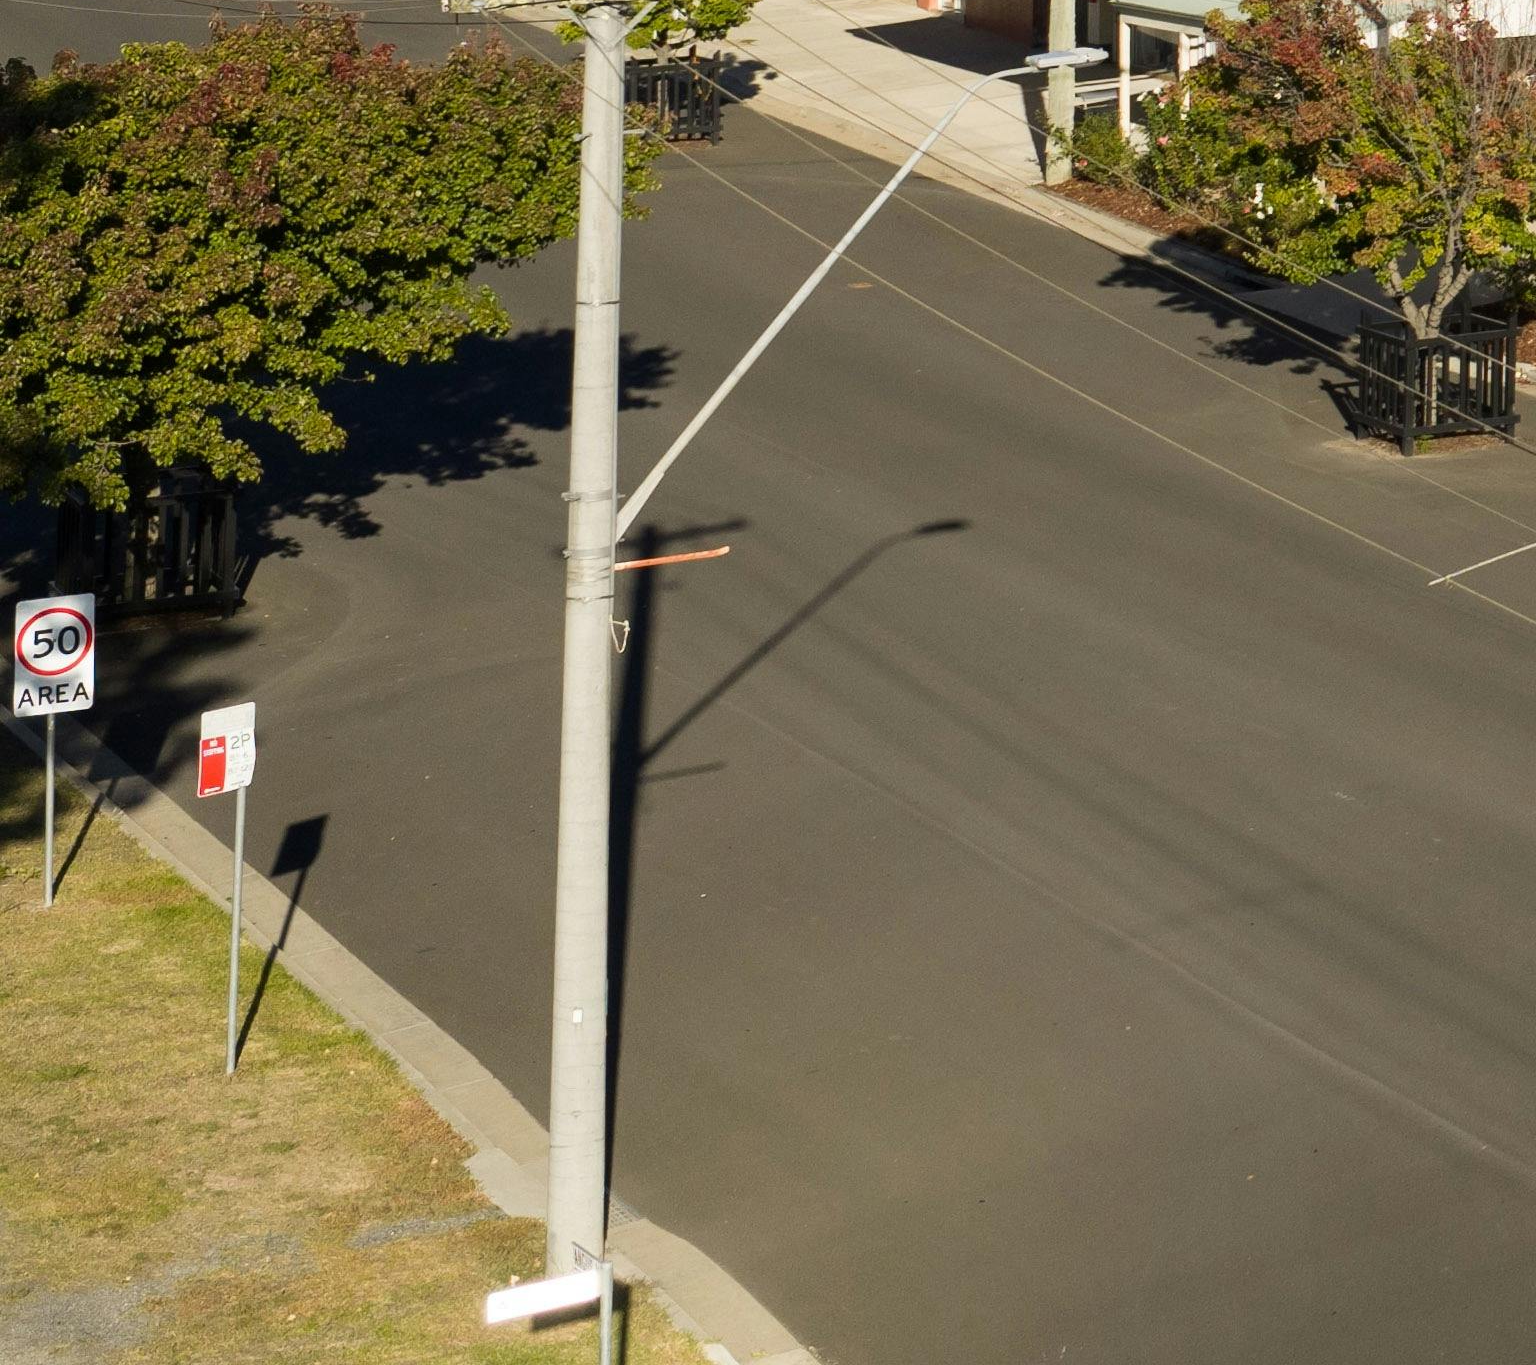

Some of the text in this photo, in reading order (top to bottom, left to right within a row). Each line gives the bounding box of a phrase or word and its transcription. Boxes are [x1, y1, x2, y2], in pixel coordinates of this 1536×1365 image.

[33, 626, 79, 658] 50
[18, 682, 89, 709] AREA
[230, 733, 250, 750] 2P
